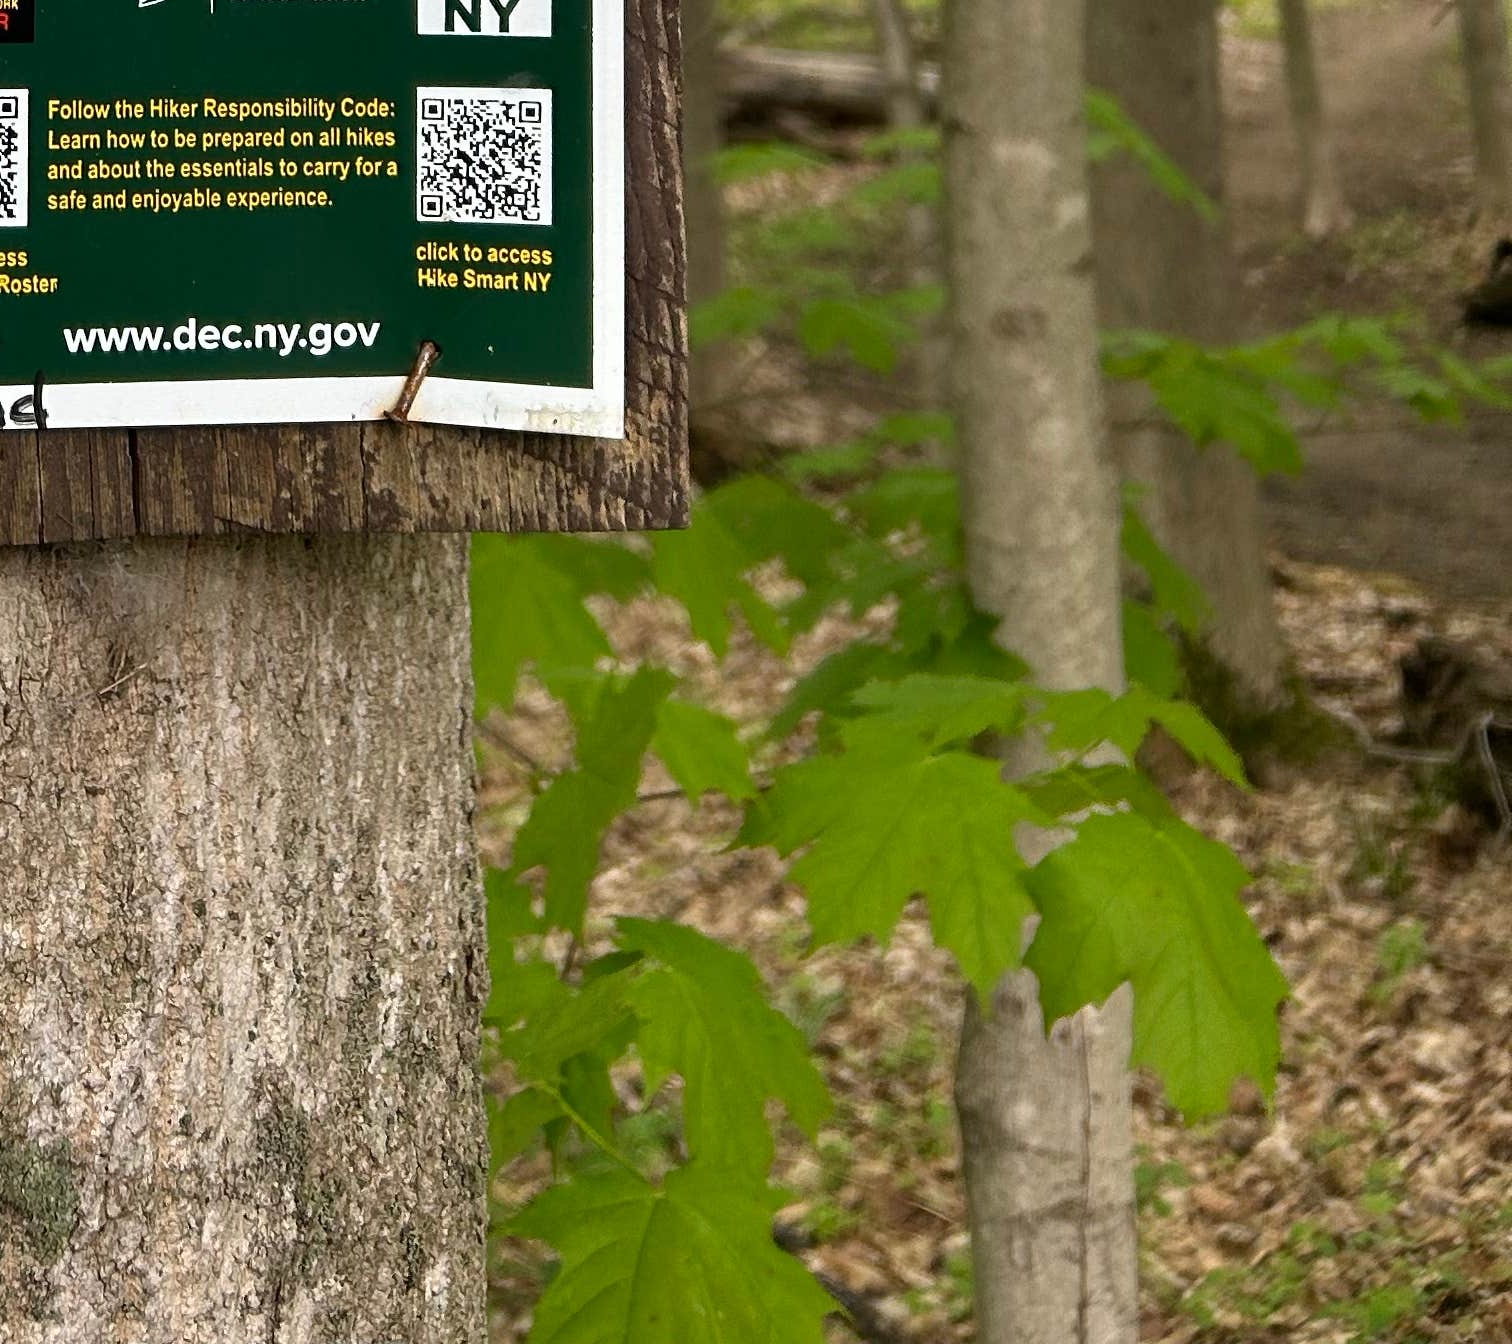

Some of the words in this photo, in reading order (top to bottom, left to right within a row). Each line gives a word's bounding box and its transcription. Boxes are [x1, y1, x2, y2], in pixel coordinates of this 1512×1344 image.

[48, 99, 111, 120] Follow
[114, 99, 145, 119] the
[150, 98, 199, 118] Hiker
[203, 97, 336, 122] Responsibility
[340, 97, 395, 118] Code:
[48, 129, 101, 150] Learn
[106, 129, 146, 149] how
[150, 129, 169, 148] to
[174, 128, 197, 148] be
[202, 127, 285, 152] prepared
[290, 131, 314, 147] on
[318, 127, 341, 147] all
[346, 126, 396, 147] hikes
[47, 159, 83, 180] and
[87, 159, 141, 179] about
[145, 158, 176, 178] the
[180, 157, 274, 178] essentials
[278, 158, 298, 177] to
[302, 161, 351, 181] carry
[354, 156, 384, 176] for
[386, 160, 398, 176] a
[47, 189, 87, 210] safe
[92, 189, 127, 210] and
[131, 187, 222, 213] enjoyable
[226, 186, 333, 211] experience.
[416, 241, 460, 262] click
[463, 243, 483, 262] to
[487, 247, 553, 266] access
[417, 267, 459, 288] Hike
[462, 268, 519, 291] Smart
[524, 271, 552, 292] NY
[63, 317, 381, 357] www.dec.ny.gov
